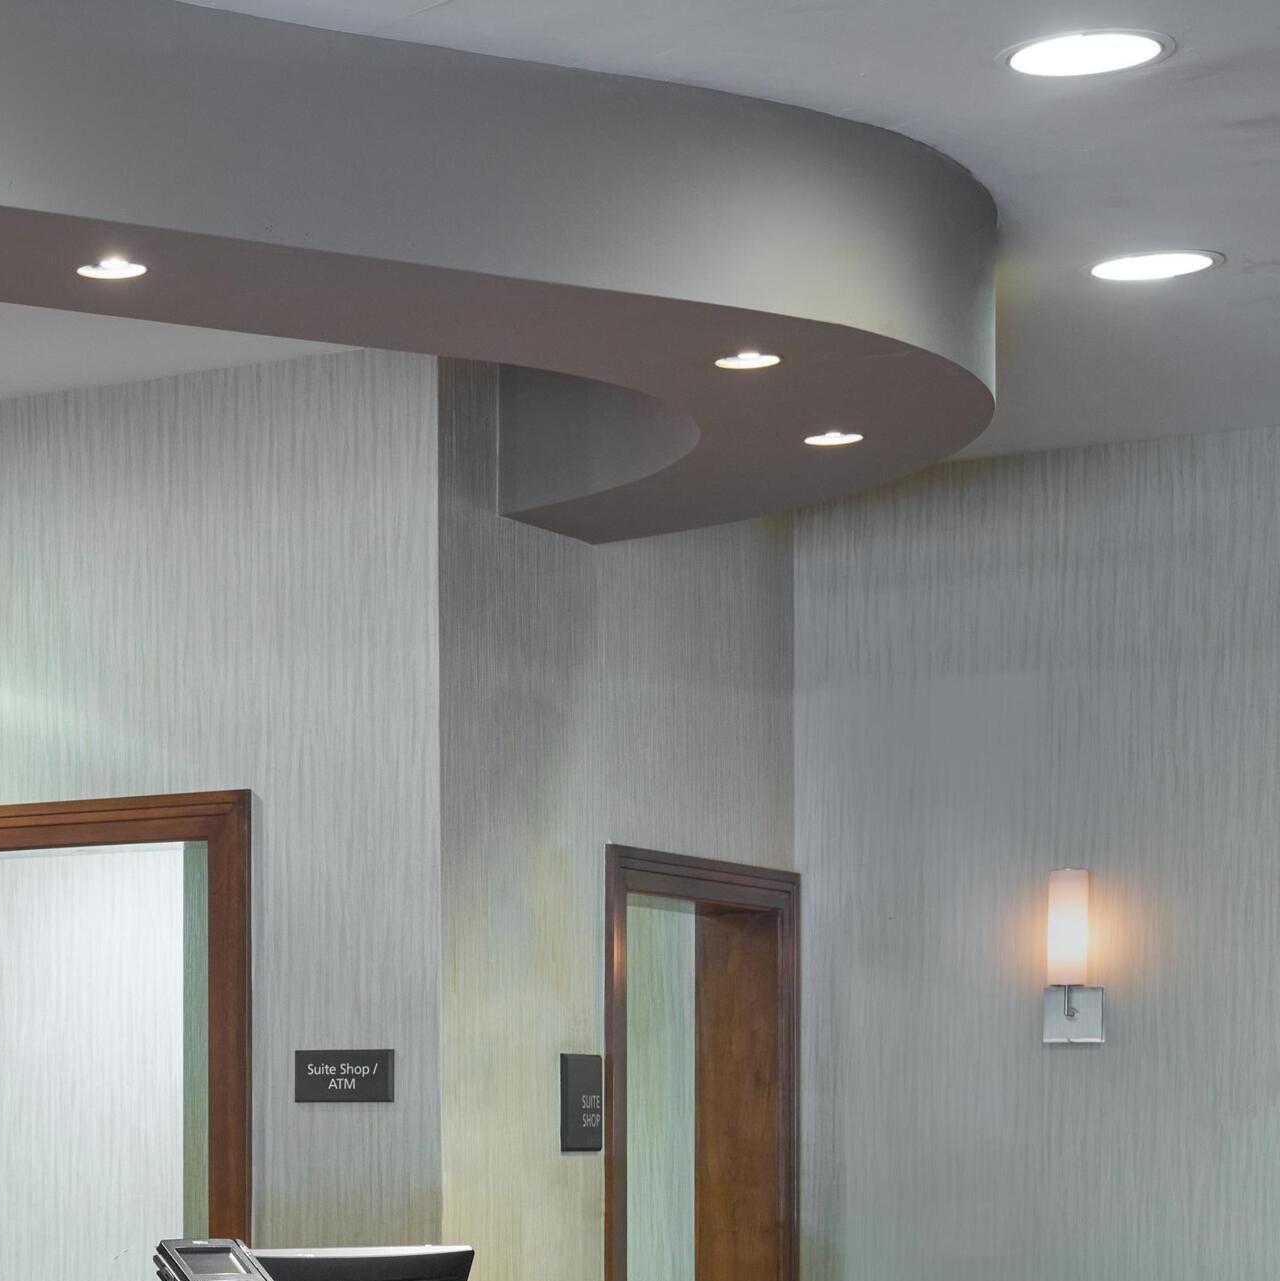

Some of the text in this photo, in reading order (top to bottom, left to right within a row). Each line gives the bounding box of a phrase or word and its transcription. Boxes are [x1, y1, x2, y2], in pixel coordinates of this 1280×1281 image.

[307, 1062, 378, 1077] Suite Shop /
[328, 1078, 356, 1090] ATM
[582, 1095, 600, 1109] SUITE
[582, 1113, 600, 1128] SHOP
